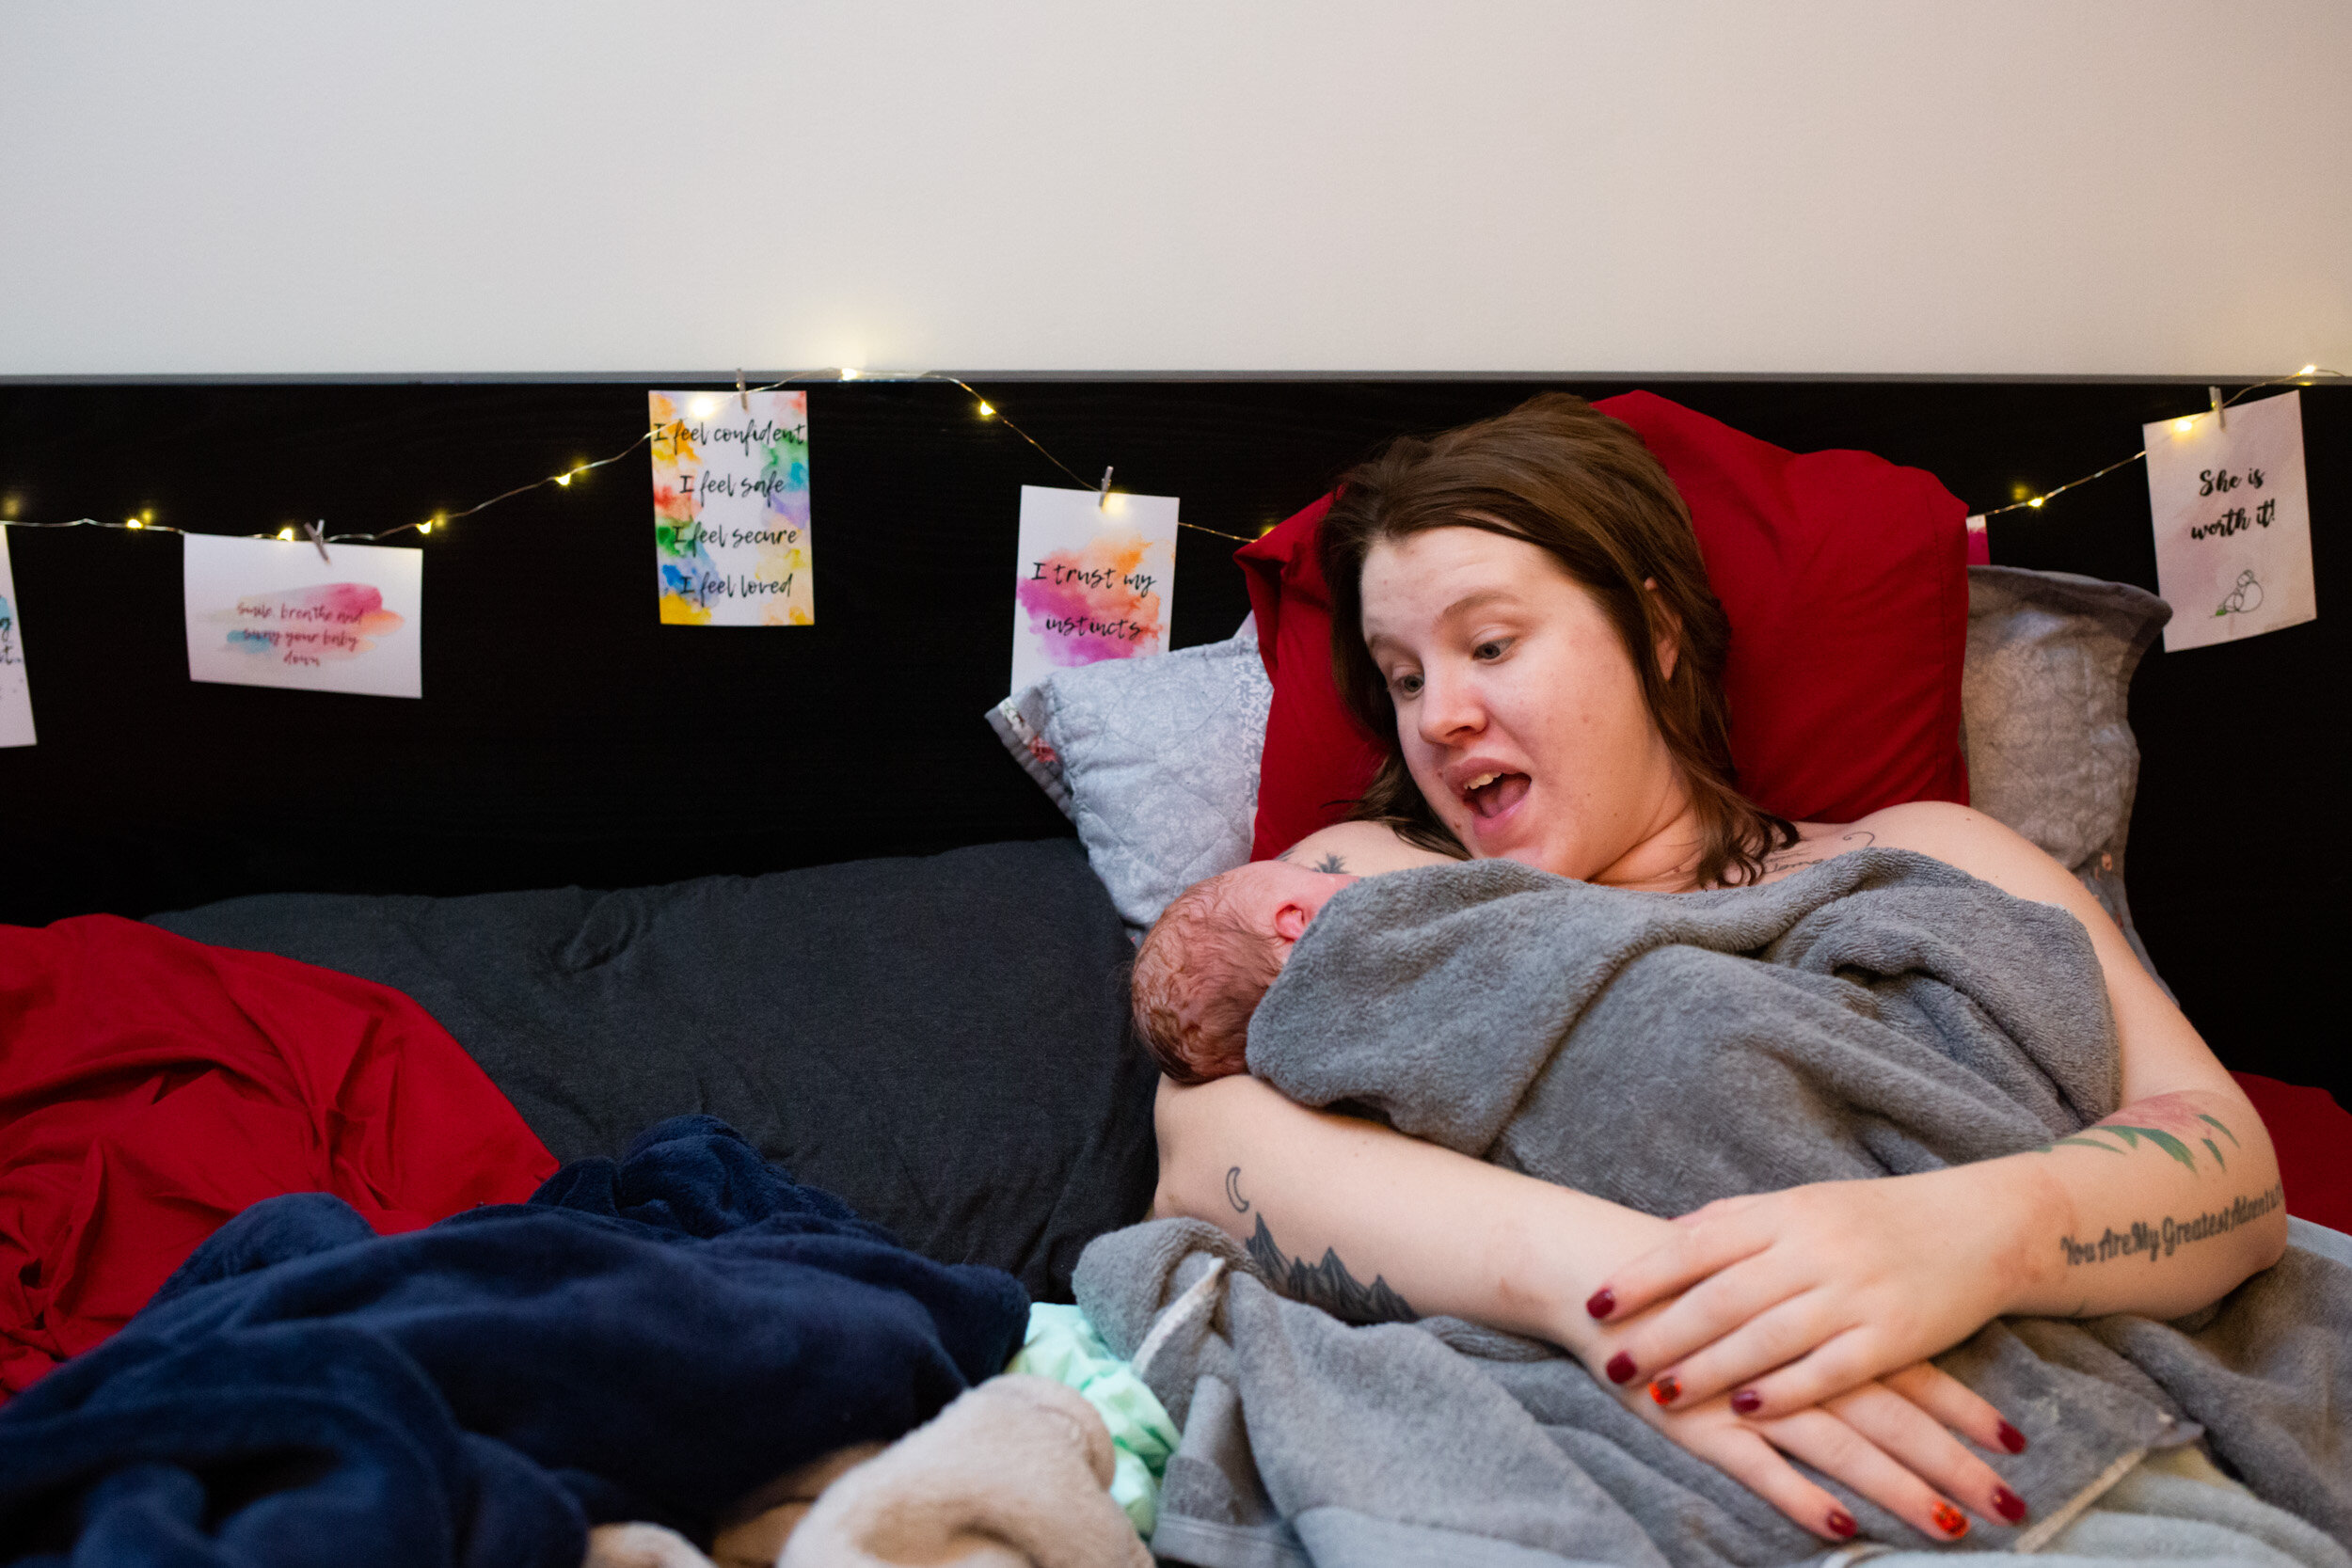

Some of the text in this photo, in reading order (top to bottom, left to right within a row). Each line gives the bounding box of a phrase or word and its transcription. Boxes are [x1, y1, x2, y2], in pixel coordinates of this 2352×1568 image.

[653, 419, 806, 456] I feel confident
[678, 470, 786, 508] I feel safe
[2199, 467, 2266, 497] She is
[2190, 499, 2277, 541] worth it!
[672, 521, 798, 558] I feel secure
[679, 572, 794, 609] I feel loved
[1030, 562, 1157, 598] I trust my
[285, 632, 319, 647] your
[322, 630, 358, 652] baby
[1045, 613, 1142, 641] instincts
[283, 650, 321, 667] down
[2060, 1234, 2097, 1266] You
[2097, 1227, 2133, 1263] Are
[2130, 1221, 2159, 1262] My
[2162, 1207, 2230, 1257] Greatest
